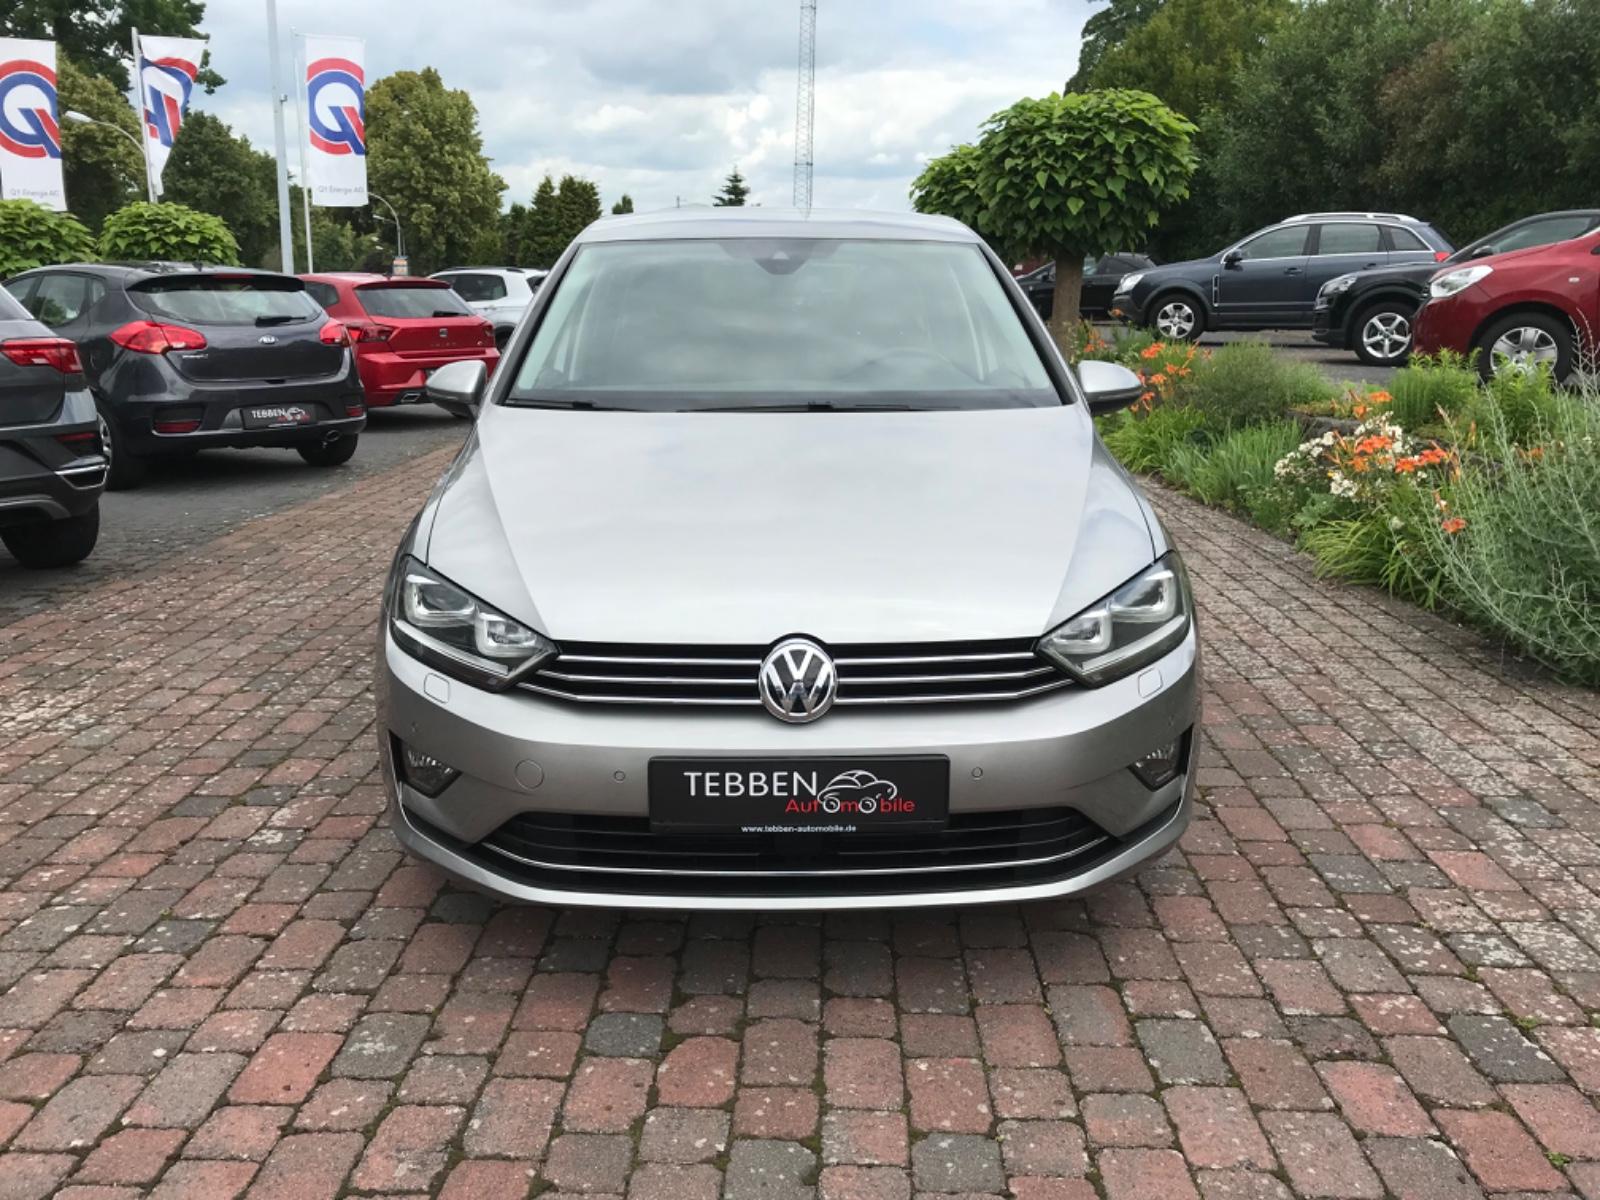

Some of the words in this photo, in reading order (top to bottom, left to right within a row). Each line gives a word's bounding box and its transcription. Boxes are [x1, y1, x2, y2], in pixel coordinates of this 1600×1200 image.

[251, 408, 286, 419] TEBBEN
[683, 771, 817, 797] TEBBEN
[741, 824, 857, 833] www.tebben-automobile.de
